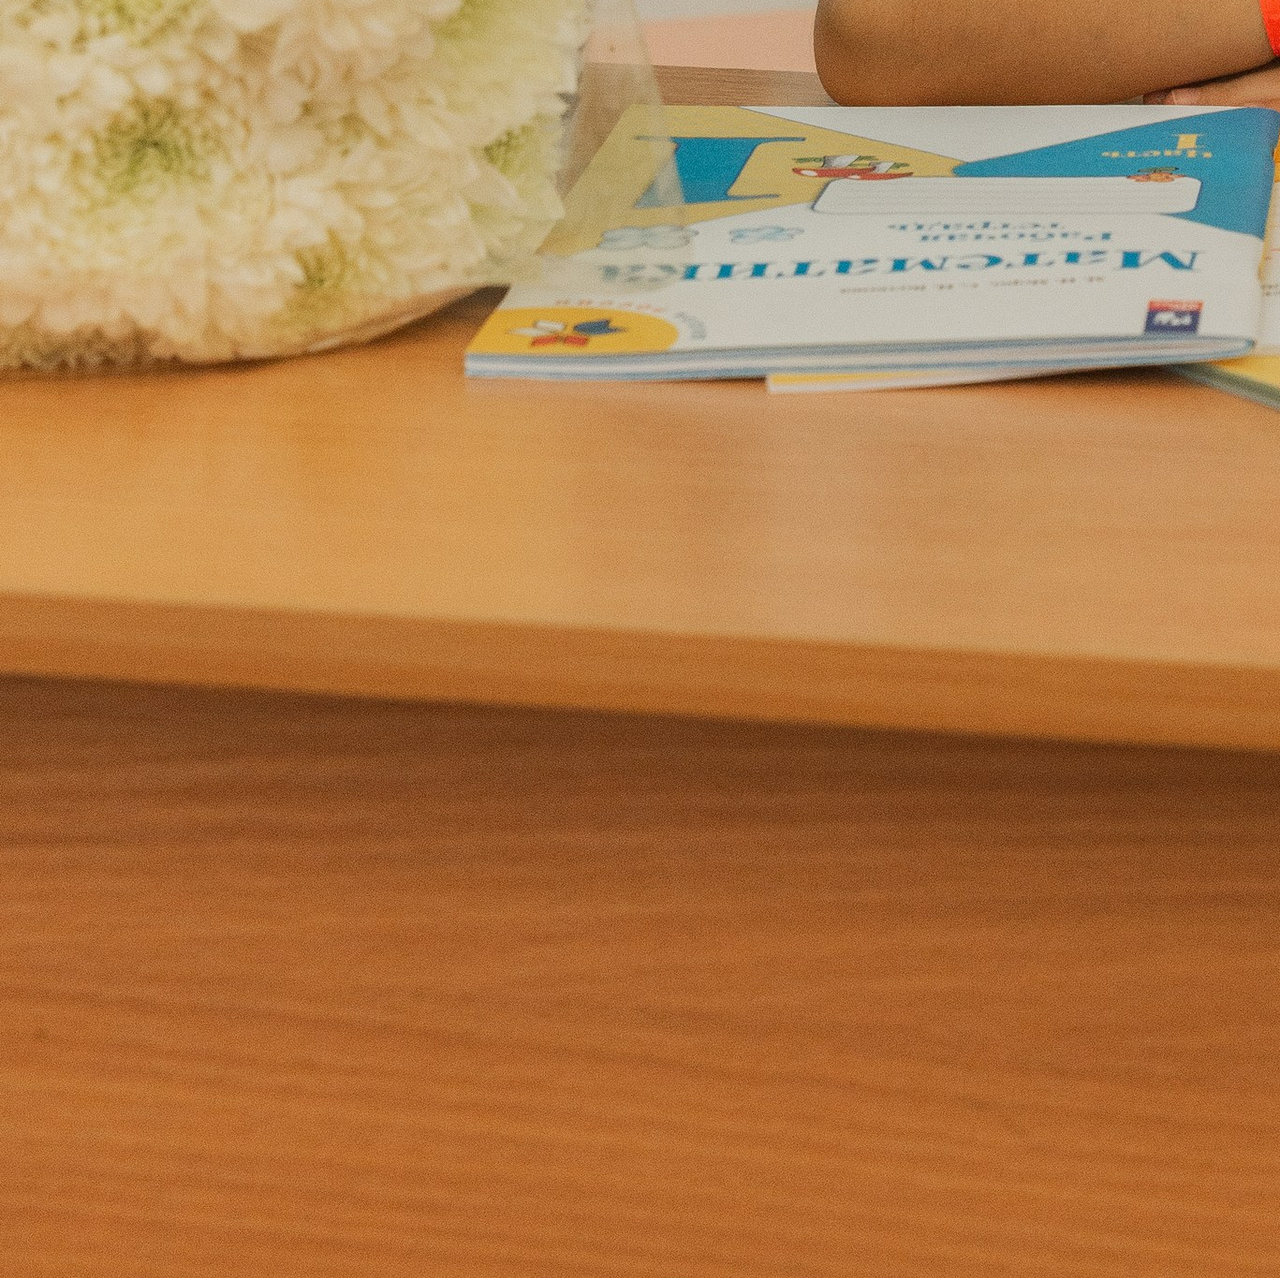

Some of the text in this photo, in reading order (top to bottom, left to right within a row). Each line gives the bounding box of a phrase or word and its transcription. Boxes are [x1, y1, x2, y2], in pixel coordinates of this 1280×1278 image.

[1170, 133, 1207, 150] 1
[1101, 149, 1213, 160] Часть
[634, 135, 805, 208] 1
[600, 250, 1204, 283] Математика
